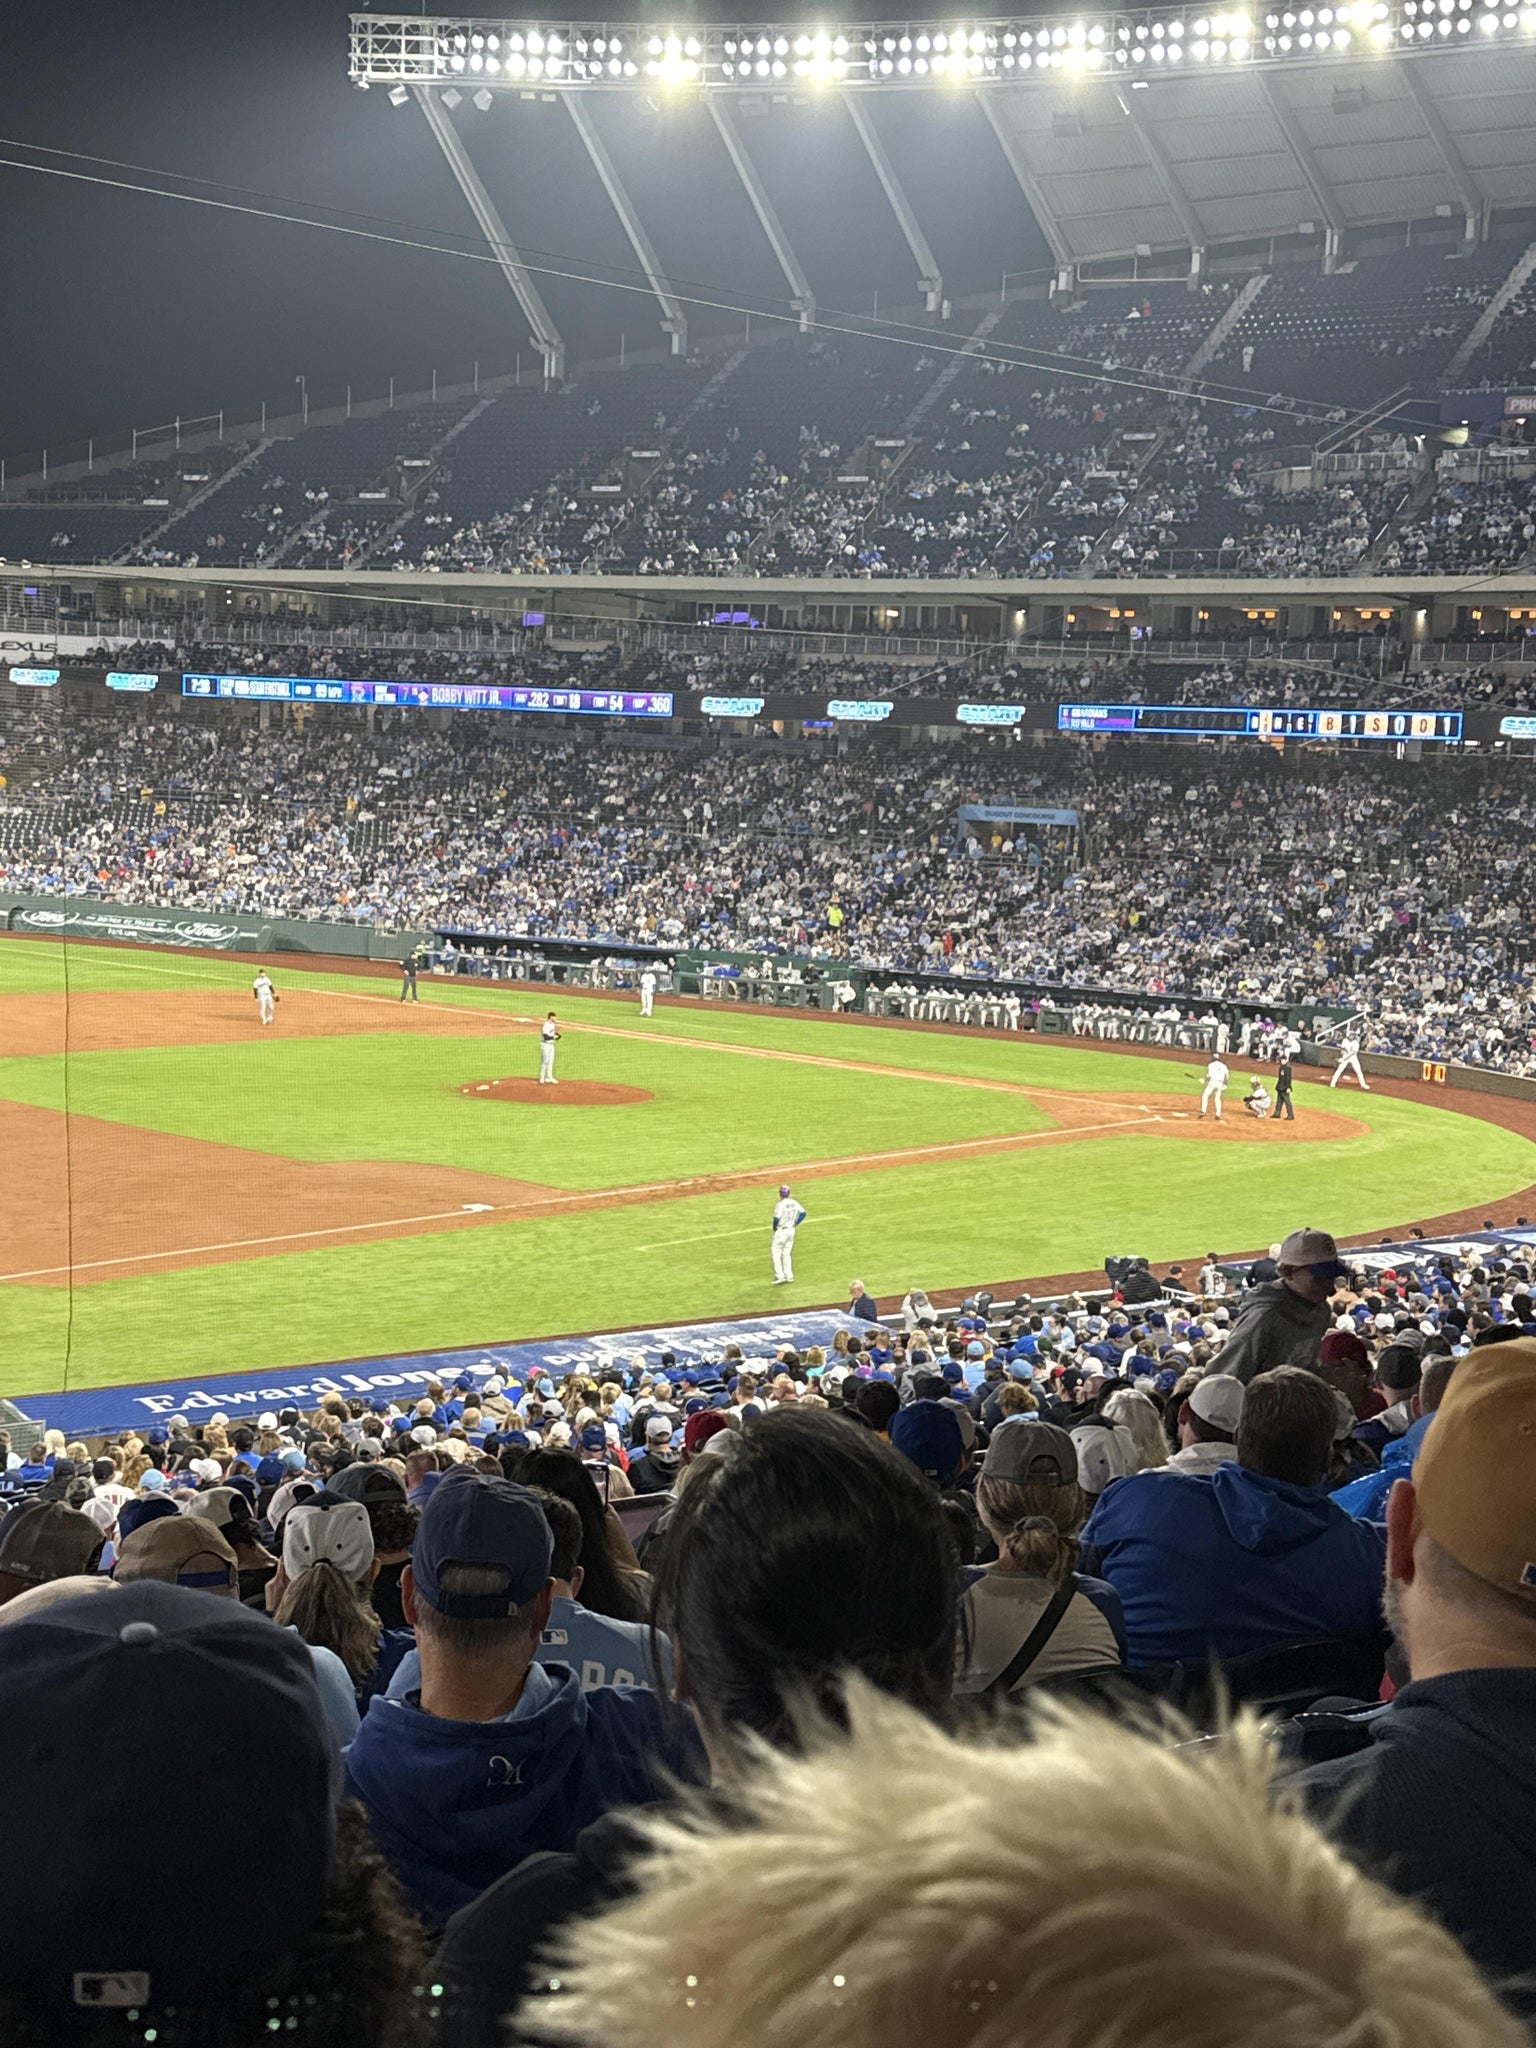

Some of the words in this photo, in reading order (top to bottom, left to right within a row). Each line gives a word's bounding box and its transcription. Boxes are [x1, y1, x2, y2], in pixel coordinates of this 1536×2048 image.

[0, 640, 58, 653] EXUS
[432, 687, 463, 703] BOBBY
[464, 689, 488, 704] WITT
[488, 690, 502, 706] JR.
[527, 691, 549, 708] .282
[609, 695, 623, 711] 54
[647, 697, 670, 713] .360
[827, 700, 894, 717] SMART
[956, 704, 1025, 722] SMART
[1326, 717, 1334, 731] B
[1350, 715, 1356, 734] 1
[1372, 718, 1380, 732] S
[1394, 716, 1405, 735] 0
[1443, 717, 1451, 736] 1
[185, 922, 227, 938] Ford
[134, 1376, 350, 1414] Edward
[338, 1363, 497, 1392] Jones
